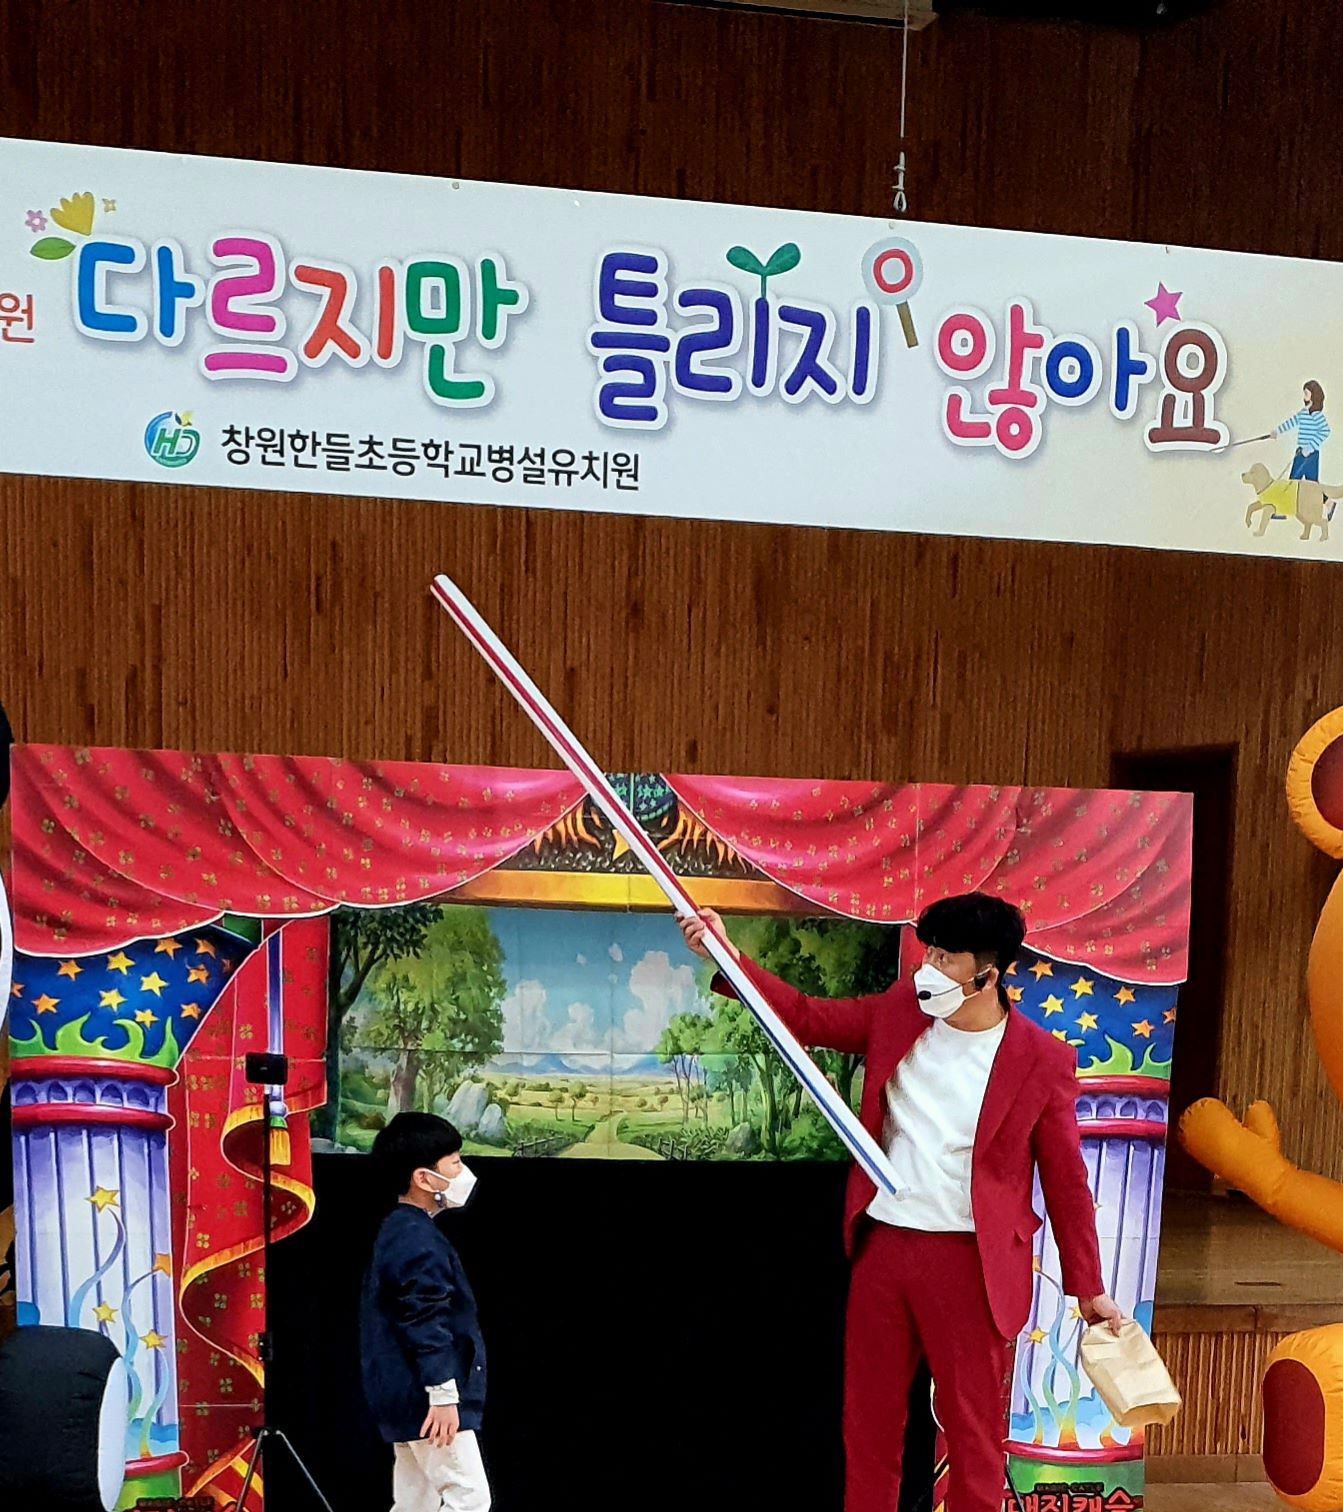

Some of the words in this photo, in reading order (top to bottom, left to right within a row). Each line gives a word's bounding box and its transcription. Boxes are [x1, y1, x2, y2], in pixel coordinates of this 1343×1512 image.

[77, 236, 521, 402] 다르지만
[589, 250, 871, 423] 틀리지
[937, 304, 1220, 452] 않아요
[221, 424, 640, 491] 창원한들초등학교병설유치원
